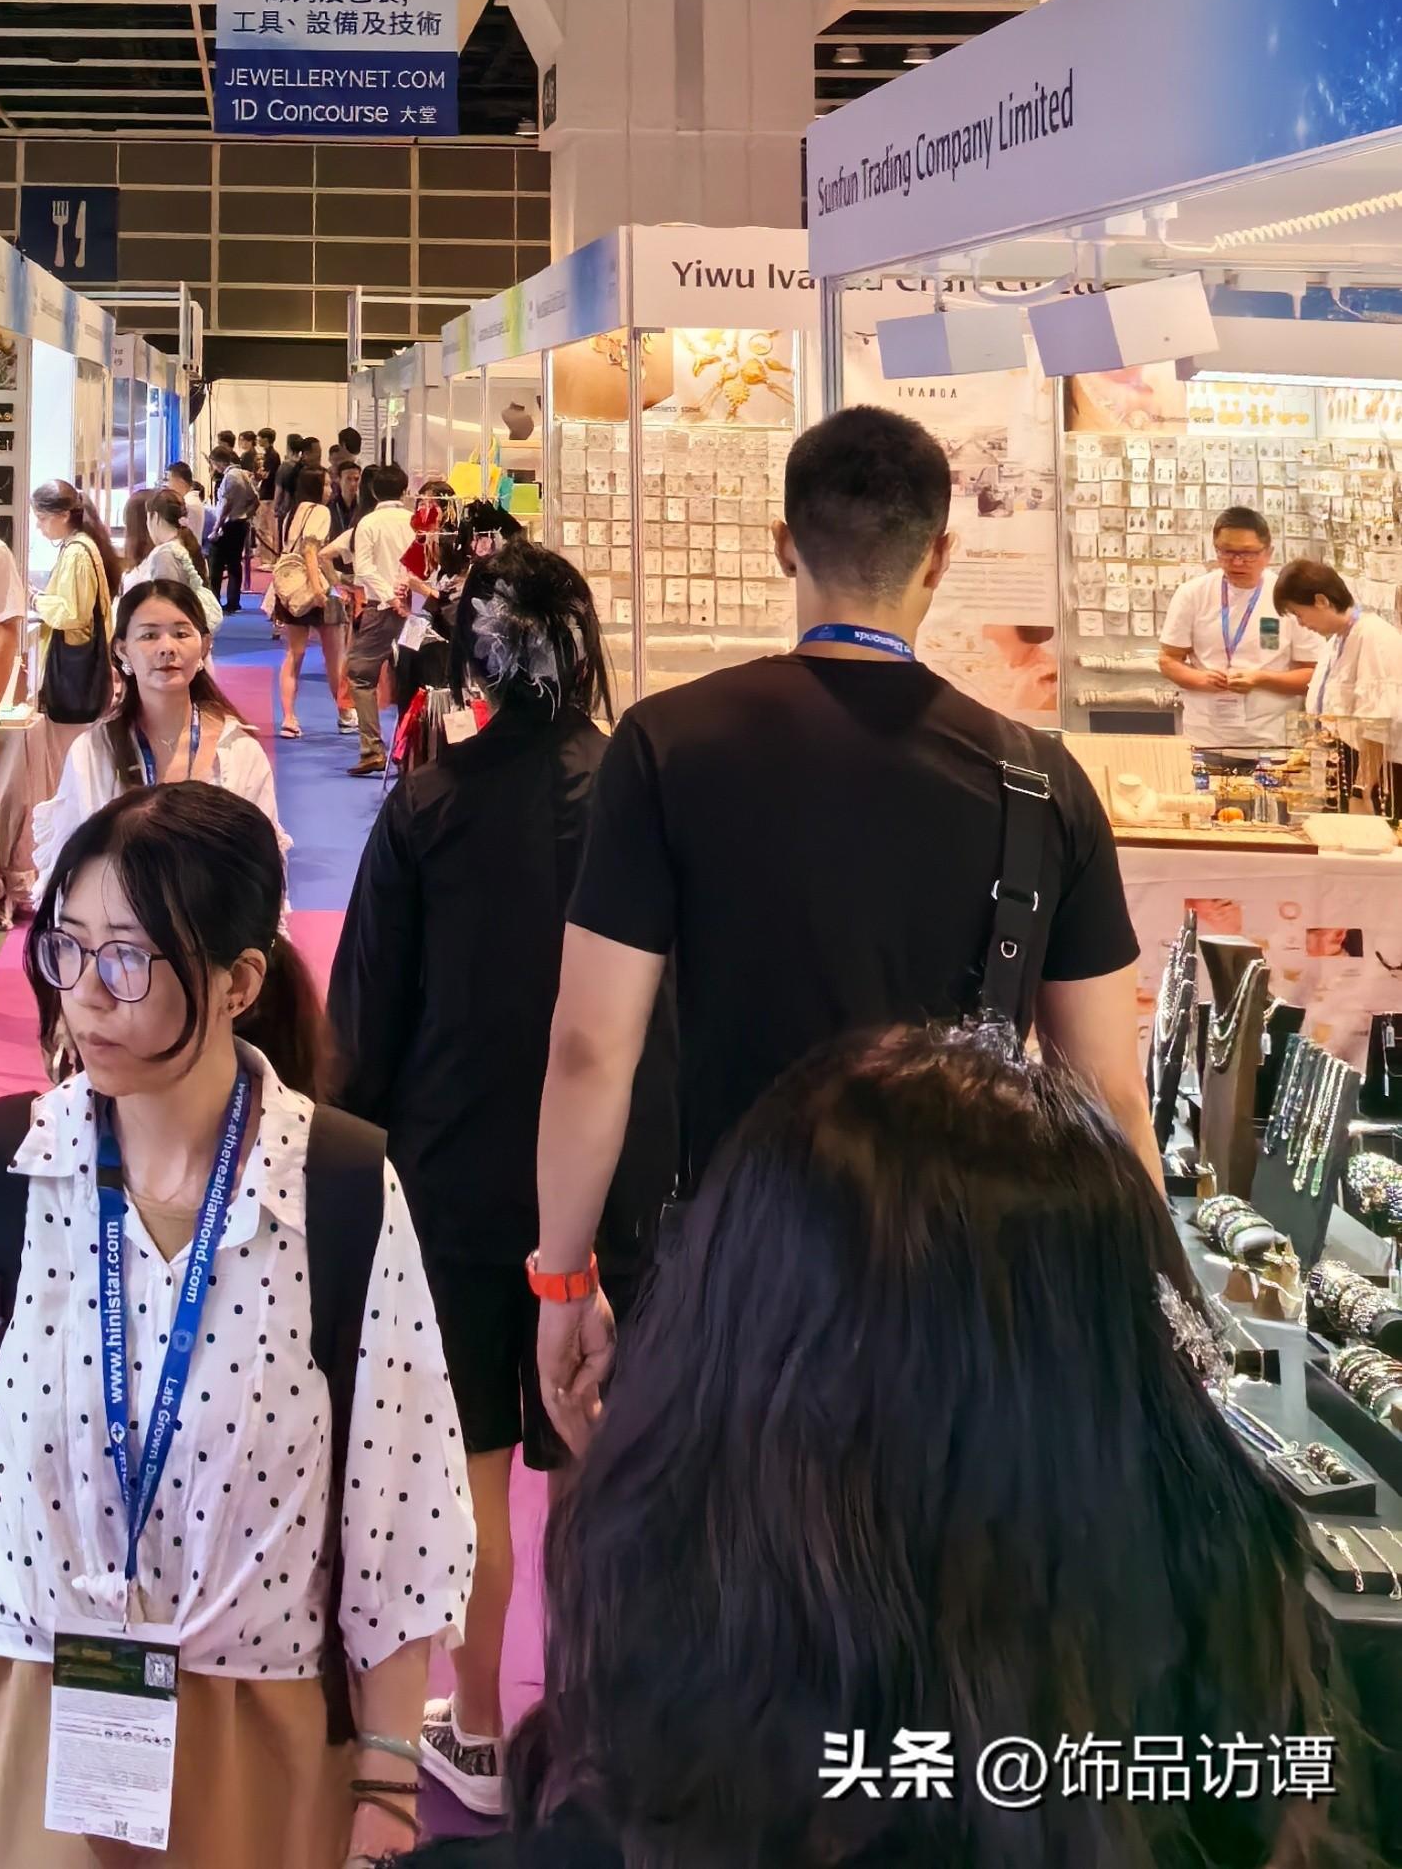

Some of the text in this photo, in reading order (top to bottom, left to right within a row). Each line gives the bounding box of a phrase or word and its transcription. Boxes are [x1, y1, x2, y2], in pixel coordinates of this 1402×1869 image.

[225, 68, 445, 89] JEWELLERYNET.COM
[232, 99, 438, 124] 1D Concourse 大堂
[818, 67, 1074, 216] Sunfun Trading Company Limited
[672, 259, 755, 288] Yiwu
[100, 1220, 124, 1405] www.hinistar.com
[149, 1375, 179, 1460] Lab Grown
